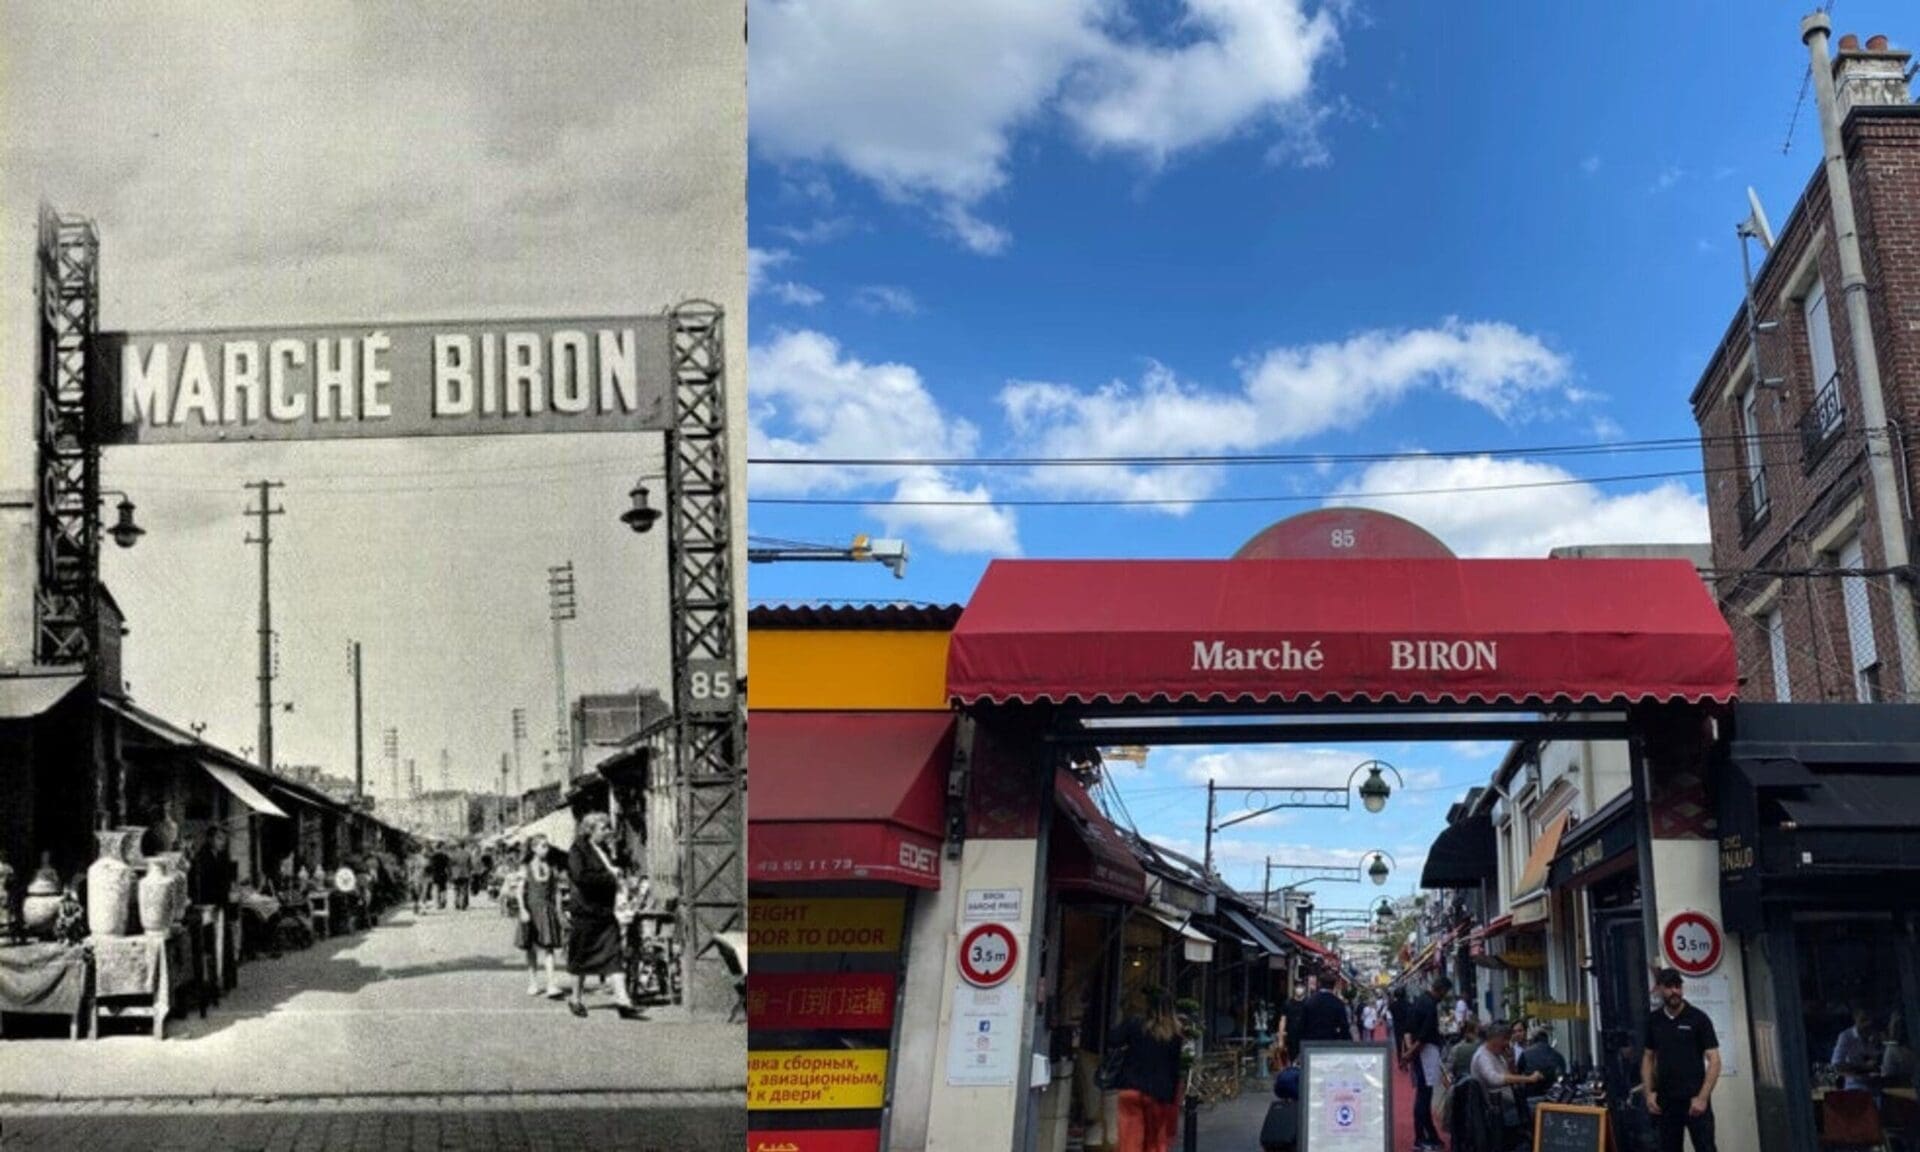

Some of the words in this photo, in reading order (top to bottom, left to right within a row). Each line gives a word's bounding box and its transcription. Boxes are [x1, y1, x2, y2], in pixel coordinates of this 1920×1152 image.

[121, 330, 392, 425] MARCHÉ
[433, 329, 637, 415] BIRON
[1331, 529, 1355, 548] 85
[1191, 640, 1325, 670] Marché
[1390, 640, 1497, 671] BIRON
[691, 671, 730, 699] 85
[899, 841, 938, 873] EDET
[796, 928, 821, 945] TO
[827, 927, 885, 945] DOOR
